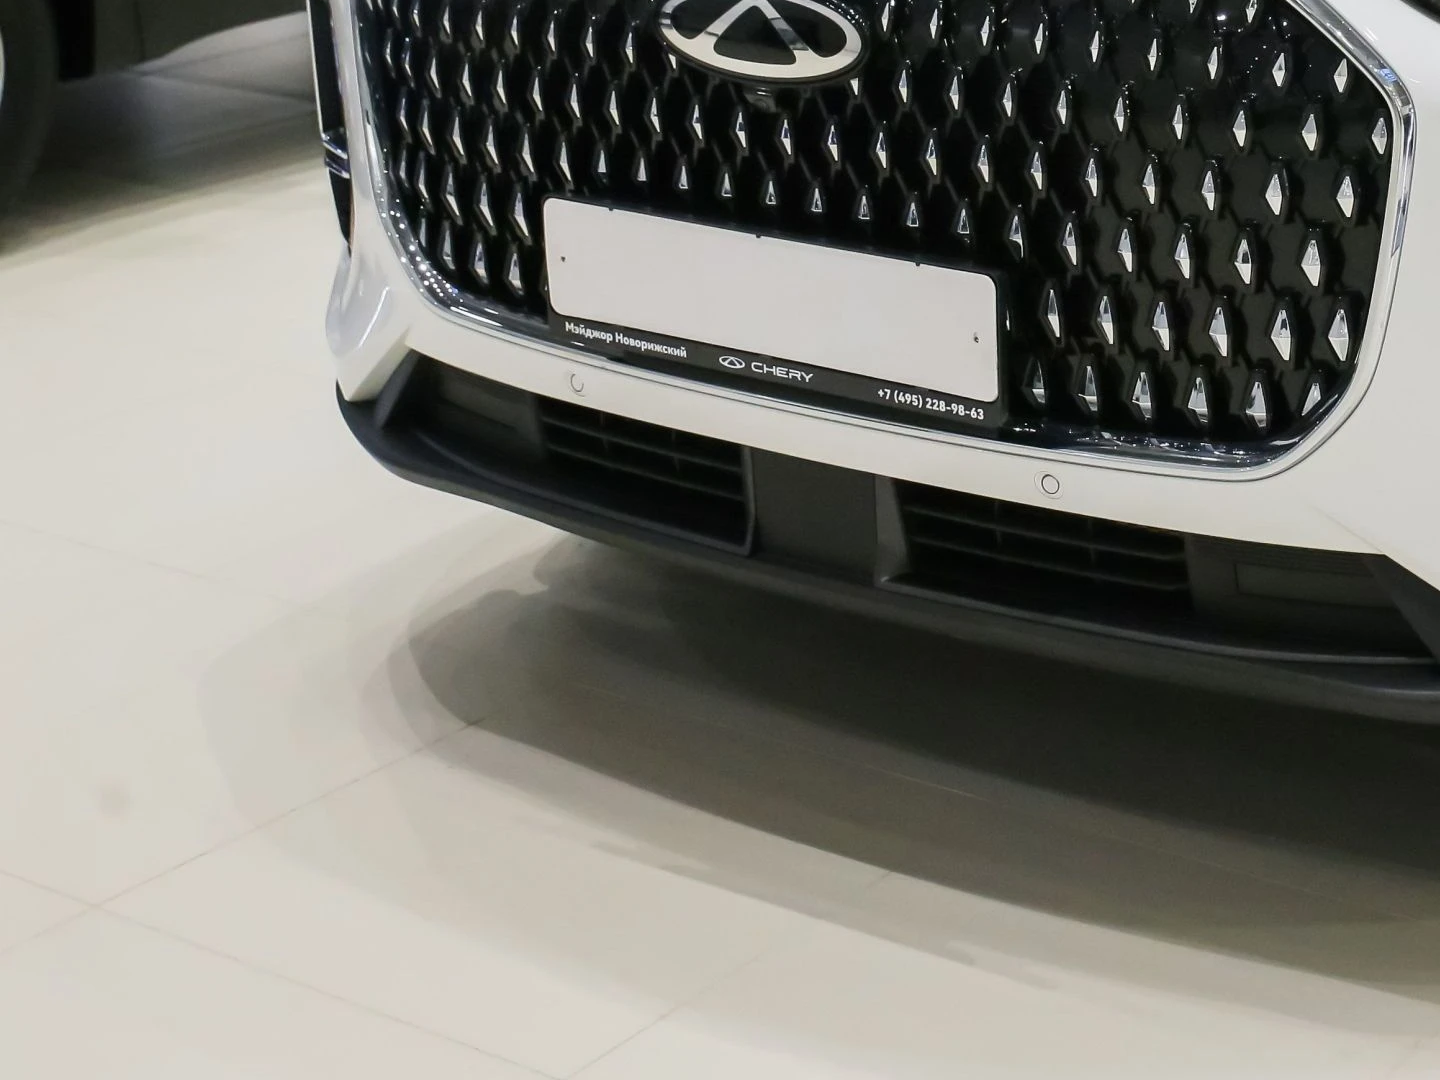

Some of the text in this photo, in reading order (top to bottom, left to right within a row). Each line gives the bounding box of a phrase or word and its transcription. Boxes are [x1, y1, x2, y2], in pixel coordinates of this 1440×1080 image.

[565, 321, 687, 358] Мэйджор Новорижский
[751, 361, 814, 383] CHERY
[877, 388, 984, 420] +7 (495) 228-98-63
